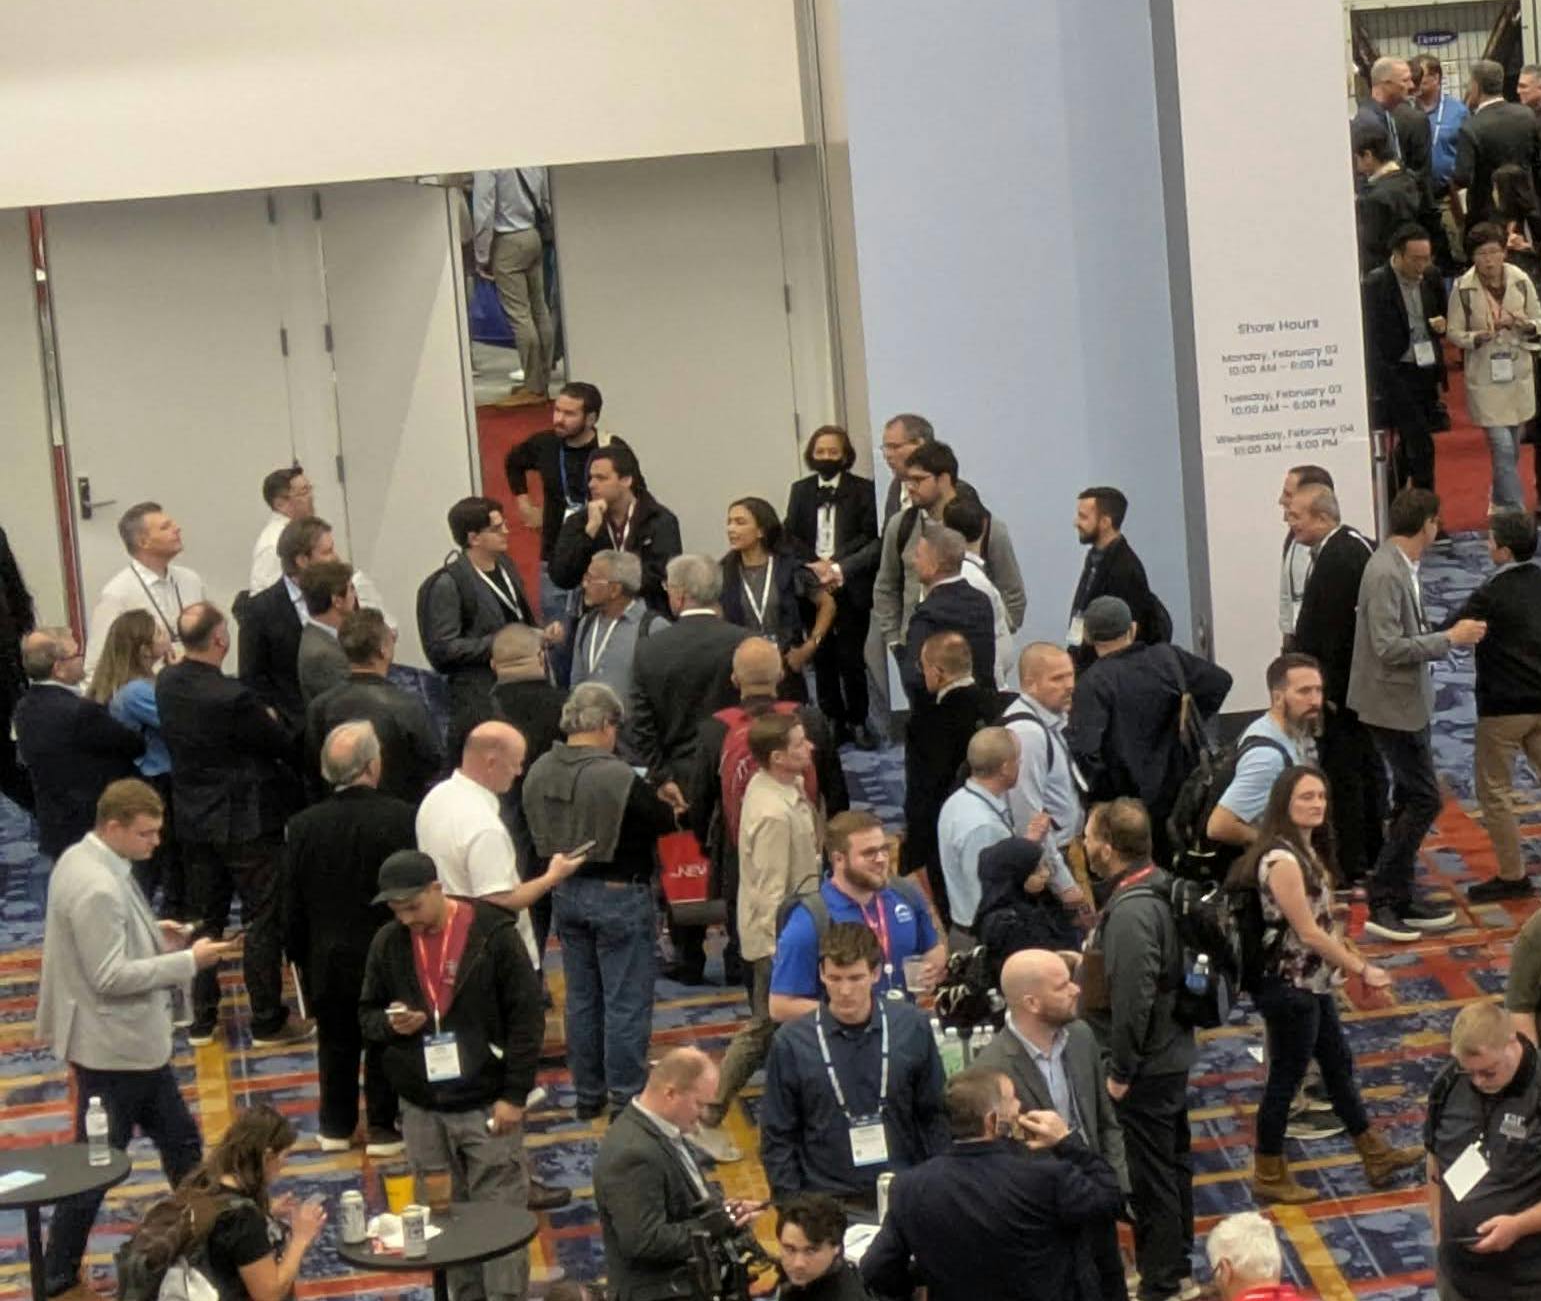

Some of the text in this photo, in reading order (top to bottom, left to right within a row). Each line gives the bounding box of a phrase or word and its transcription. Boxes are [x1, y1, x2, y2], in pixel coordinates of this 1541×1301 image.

[1237, 318, 1319, 334] Show Hours
[1260, 364, 1276, 373] AM
[1317, 358, 1333, 369] PM
[1262, 403, 1279, 413] AM
[1319, 398, 1336, 408] PM
[1265, 443, 1281, 452] AM
[1321, 438, 1338, 448] PM
